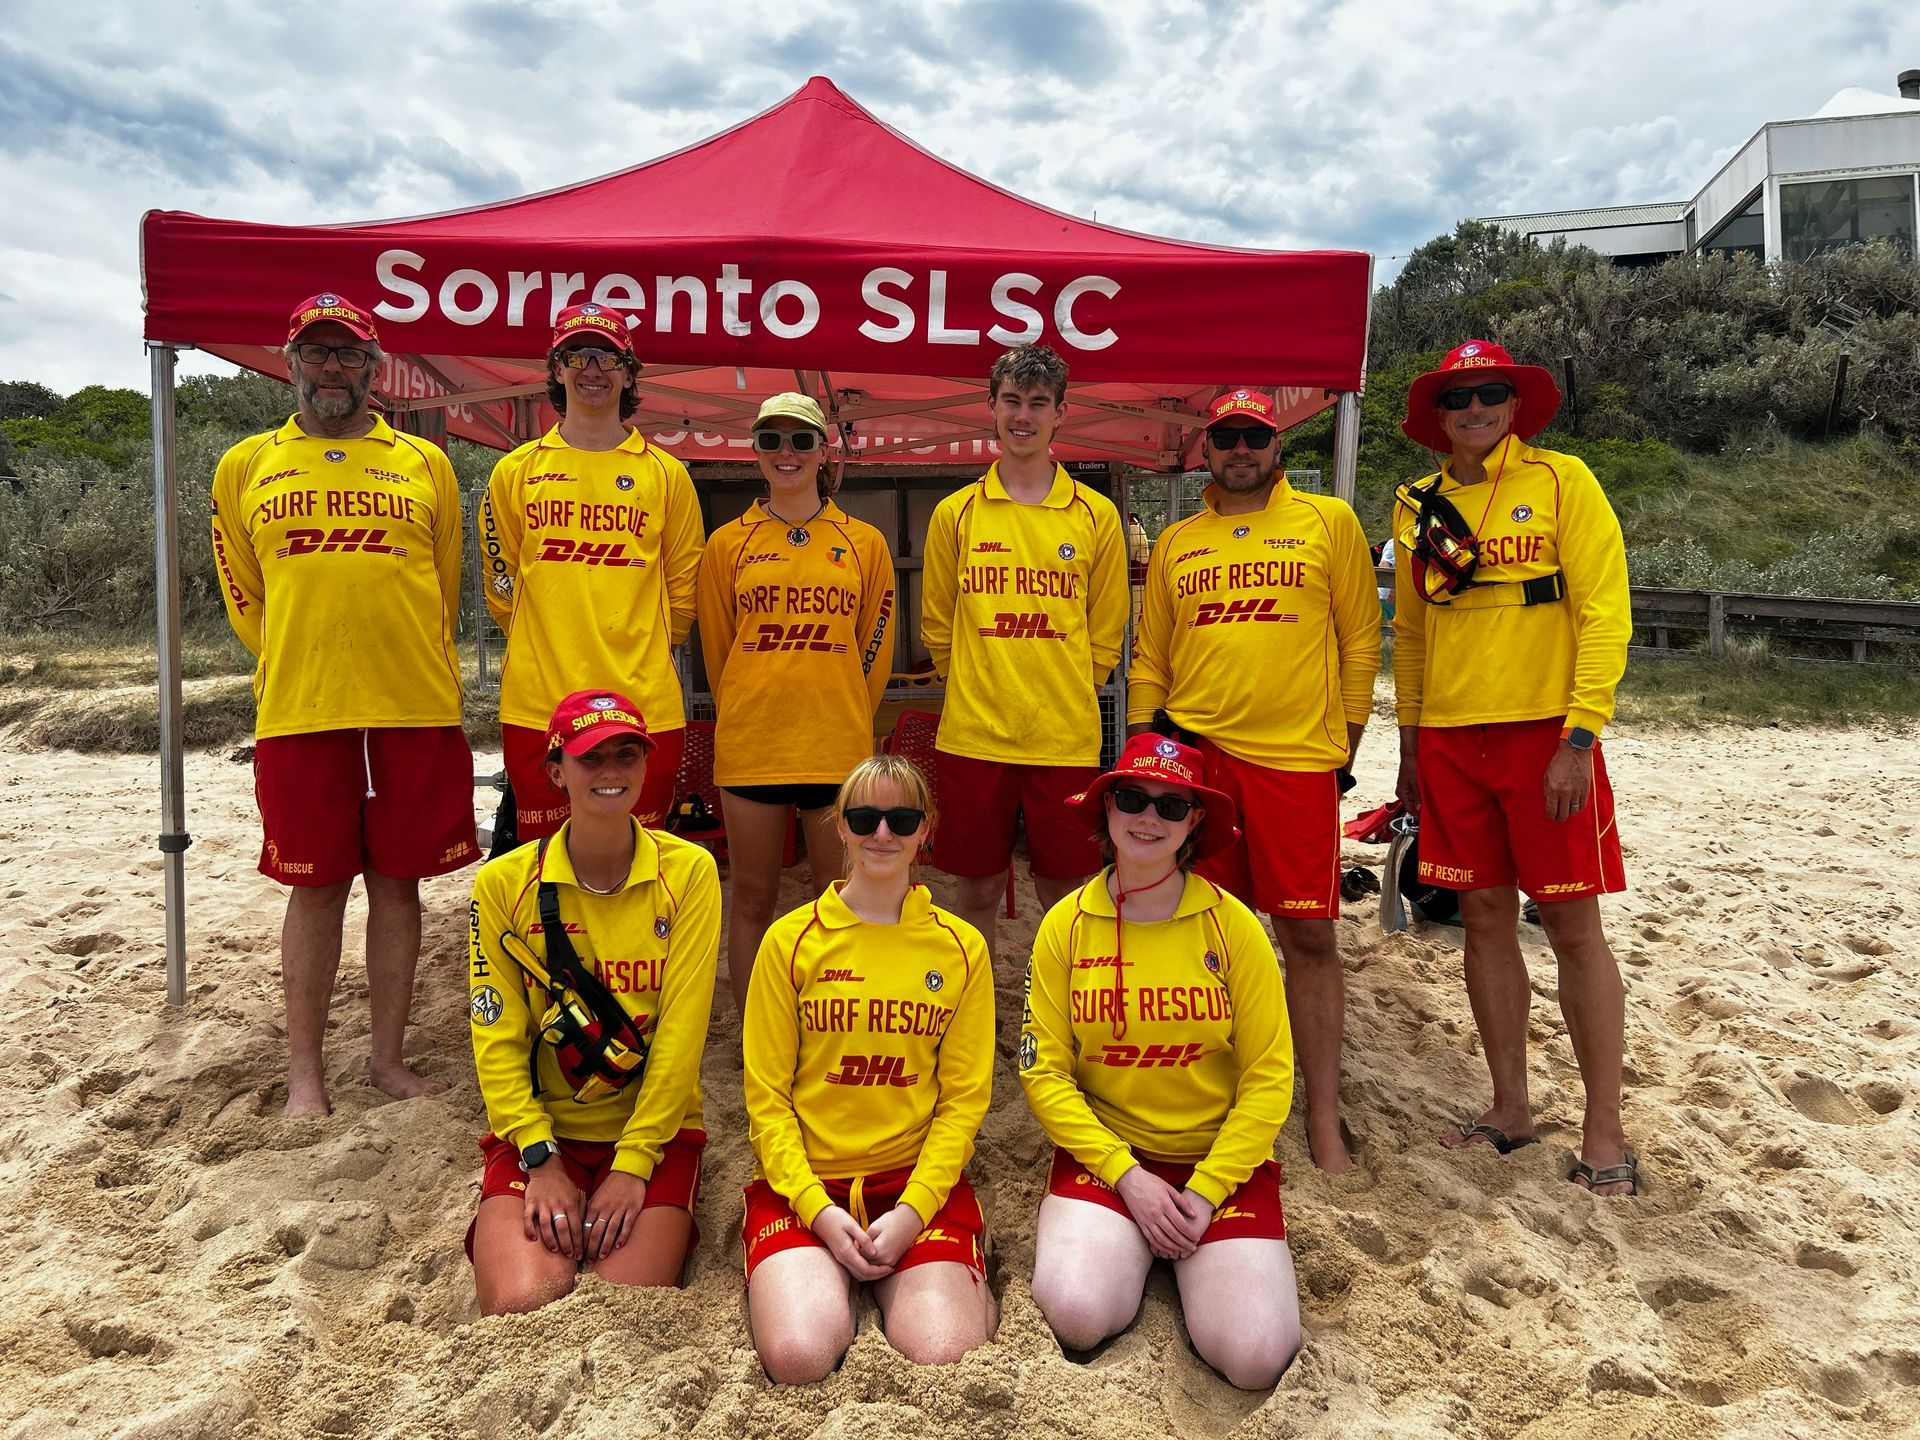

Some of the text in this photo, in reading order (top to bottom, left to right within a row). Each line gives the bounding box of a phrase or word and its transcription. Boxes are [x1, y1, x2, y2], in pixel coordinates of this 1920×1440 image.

[372, 249, 1122, 351] Sorrento SLSC
[300, 307, 360, 325] SURF RESCUE
[564, 315, 619, 333] SURF RESCUE
[1216, 400, 1235, 416] SURF
[1236, 399, 1267, 414] RESCUE
[257, 468, 301, 488] DHL
[364, 467, 410, 483] ISUZU
[374, 475, 401, 484] UTE
[526, 473, 570, 485] DHL
[261, 490, 415, 524] SURF RESCUE
[526, 501, 650, 538] SURF RESCUE
[284, 528, 393, 557] DHL
[538, 538, 632, 567] DHL
[977, 542, 1005, 552] DHL
[1263, 538, 1306, 546] ISUZU
[1476, 536, 1545, 569] ESCUE
[744, 553, 782, 564] DHL
[1176, 548, 1212, 563] DHL
[213, 527, 250, 616] AMPOL
[961, 566, 1081, 599] SURF RESCUE
[1177, 560, 1307, 600] SURF RESCUE
[739, 586, 857, 616] SURF RESCUE
[1195, 599, 1284, 627] DHL
[756, 624, 834, 652] DHL
[862, 590, 895, 678] Westpa
[993, 613, 1056, 639] DHL
[572, 710, 642, 731] SURF RESCUE
[1133, 756, 1194, 783] SURF RESCUE
[519, 803, 571, 825] SURF RESC
[283, 862, 314, 874] RESCUE
[1418, 861, 1475, 883] RF RESCUE
[1543, 882, 1588, 894] DHL
[1281, 900, 1320, 909] DHL
[1079, 956, 1123, 969] DHL
[823, 969, 856, 982] DHL
[1072, 986, 1232, 1024] SURF RESCUE
[802, 998, 953, 1038] SURF RESCUE
[838, 1055, 909, 1087] DHL
[759, 1216, 792, 1242] SURF
